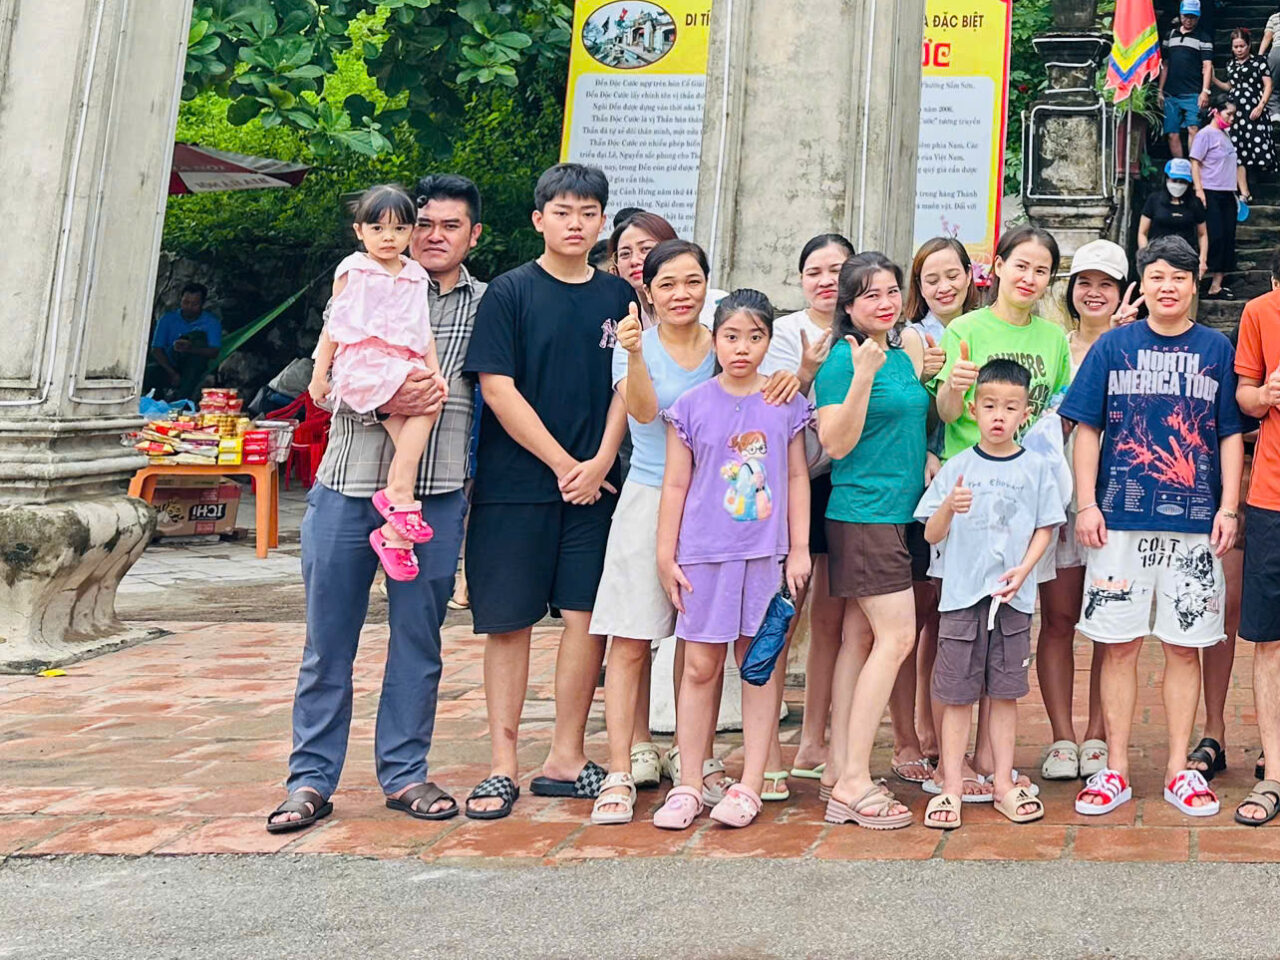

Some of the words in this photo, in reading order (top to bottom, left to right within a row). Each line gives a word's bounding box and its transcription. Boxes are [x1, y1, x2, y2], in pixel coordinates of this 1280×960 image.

[685, 13, 698, 26] DI
[933, 11, 958, 32] ĐẶC
[962, 11, 984, 32] BIỆT
[1137, 349, 1200, 375] NORTH
[1107, 369, 1181, 396] AMERICA
[1184, 372, 1220, 405] TOUR
[1137, 537, 1181, 554] COLT
[1140, 551, 1173, 569] 1971
